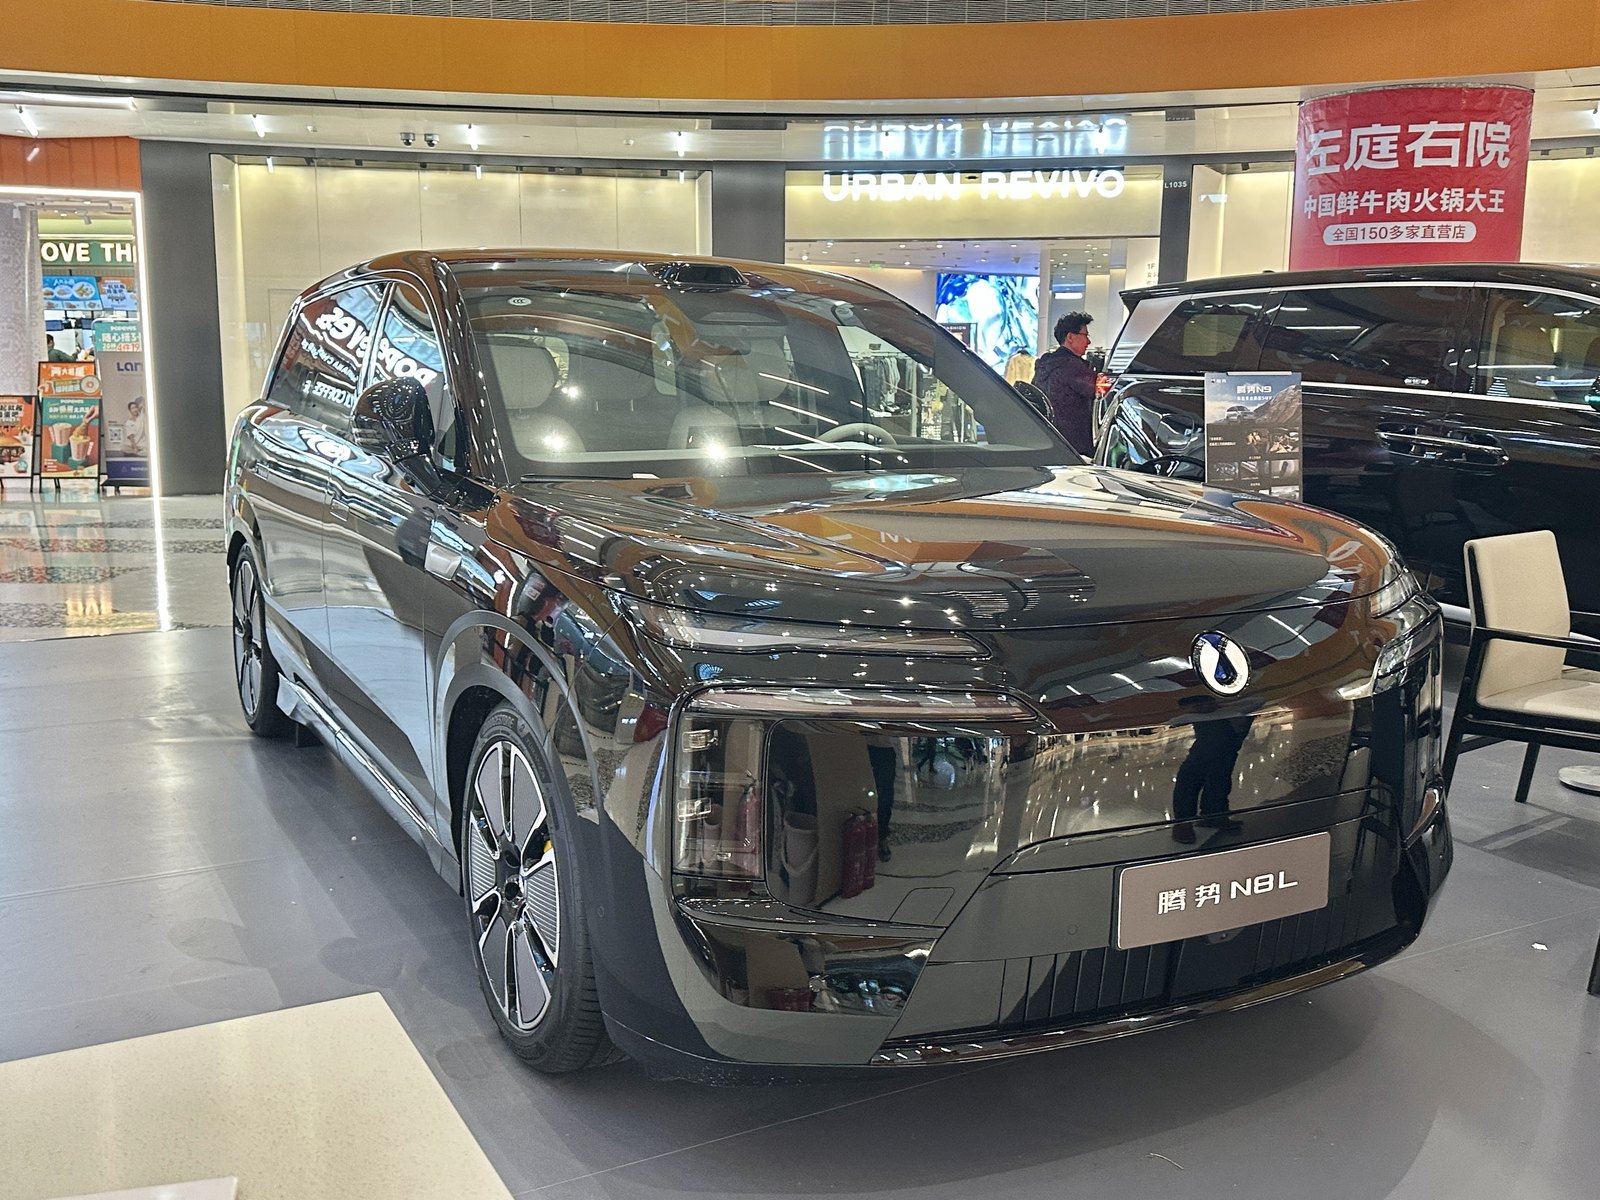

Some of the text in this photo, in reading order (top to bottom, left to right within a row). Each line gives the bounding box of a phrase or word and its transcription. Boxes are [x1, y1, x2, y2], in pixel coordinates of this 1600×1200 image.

[1306, 120, 1511, 176] 左庭右院
[822, 169, 1126, 202] URBAN REVIVO
[1164, 181, 1188, 189] L1035
[1304, 187, 1505, 219] 中国鲜牛肉火锅大王
[1332, 223, 1466, 242] 全国150多家直营店
[1157, 871, 1298, 915] 腾势 N8L
